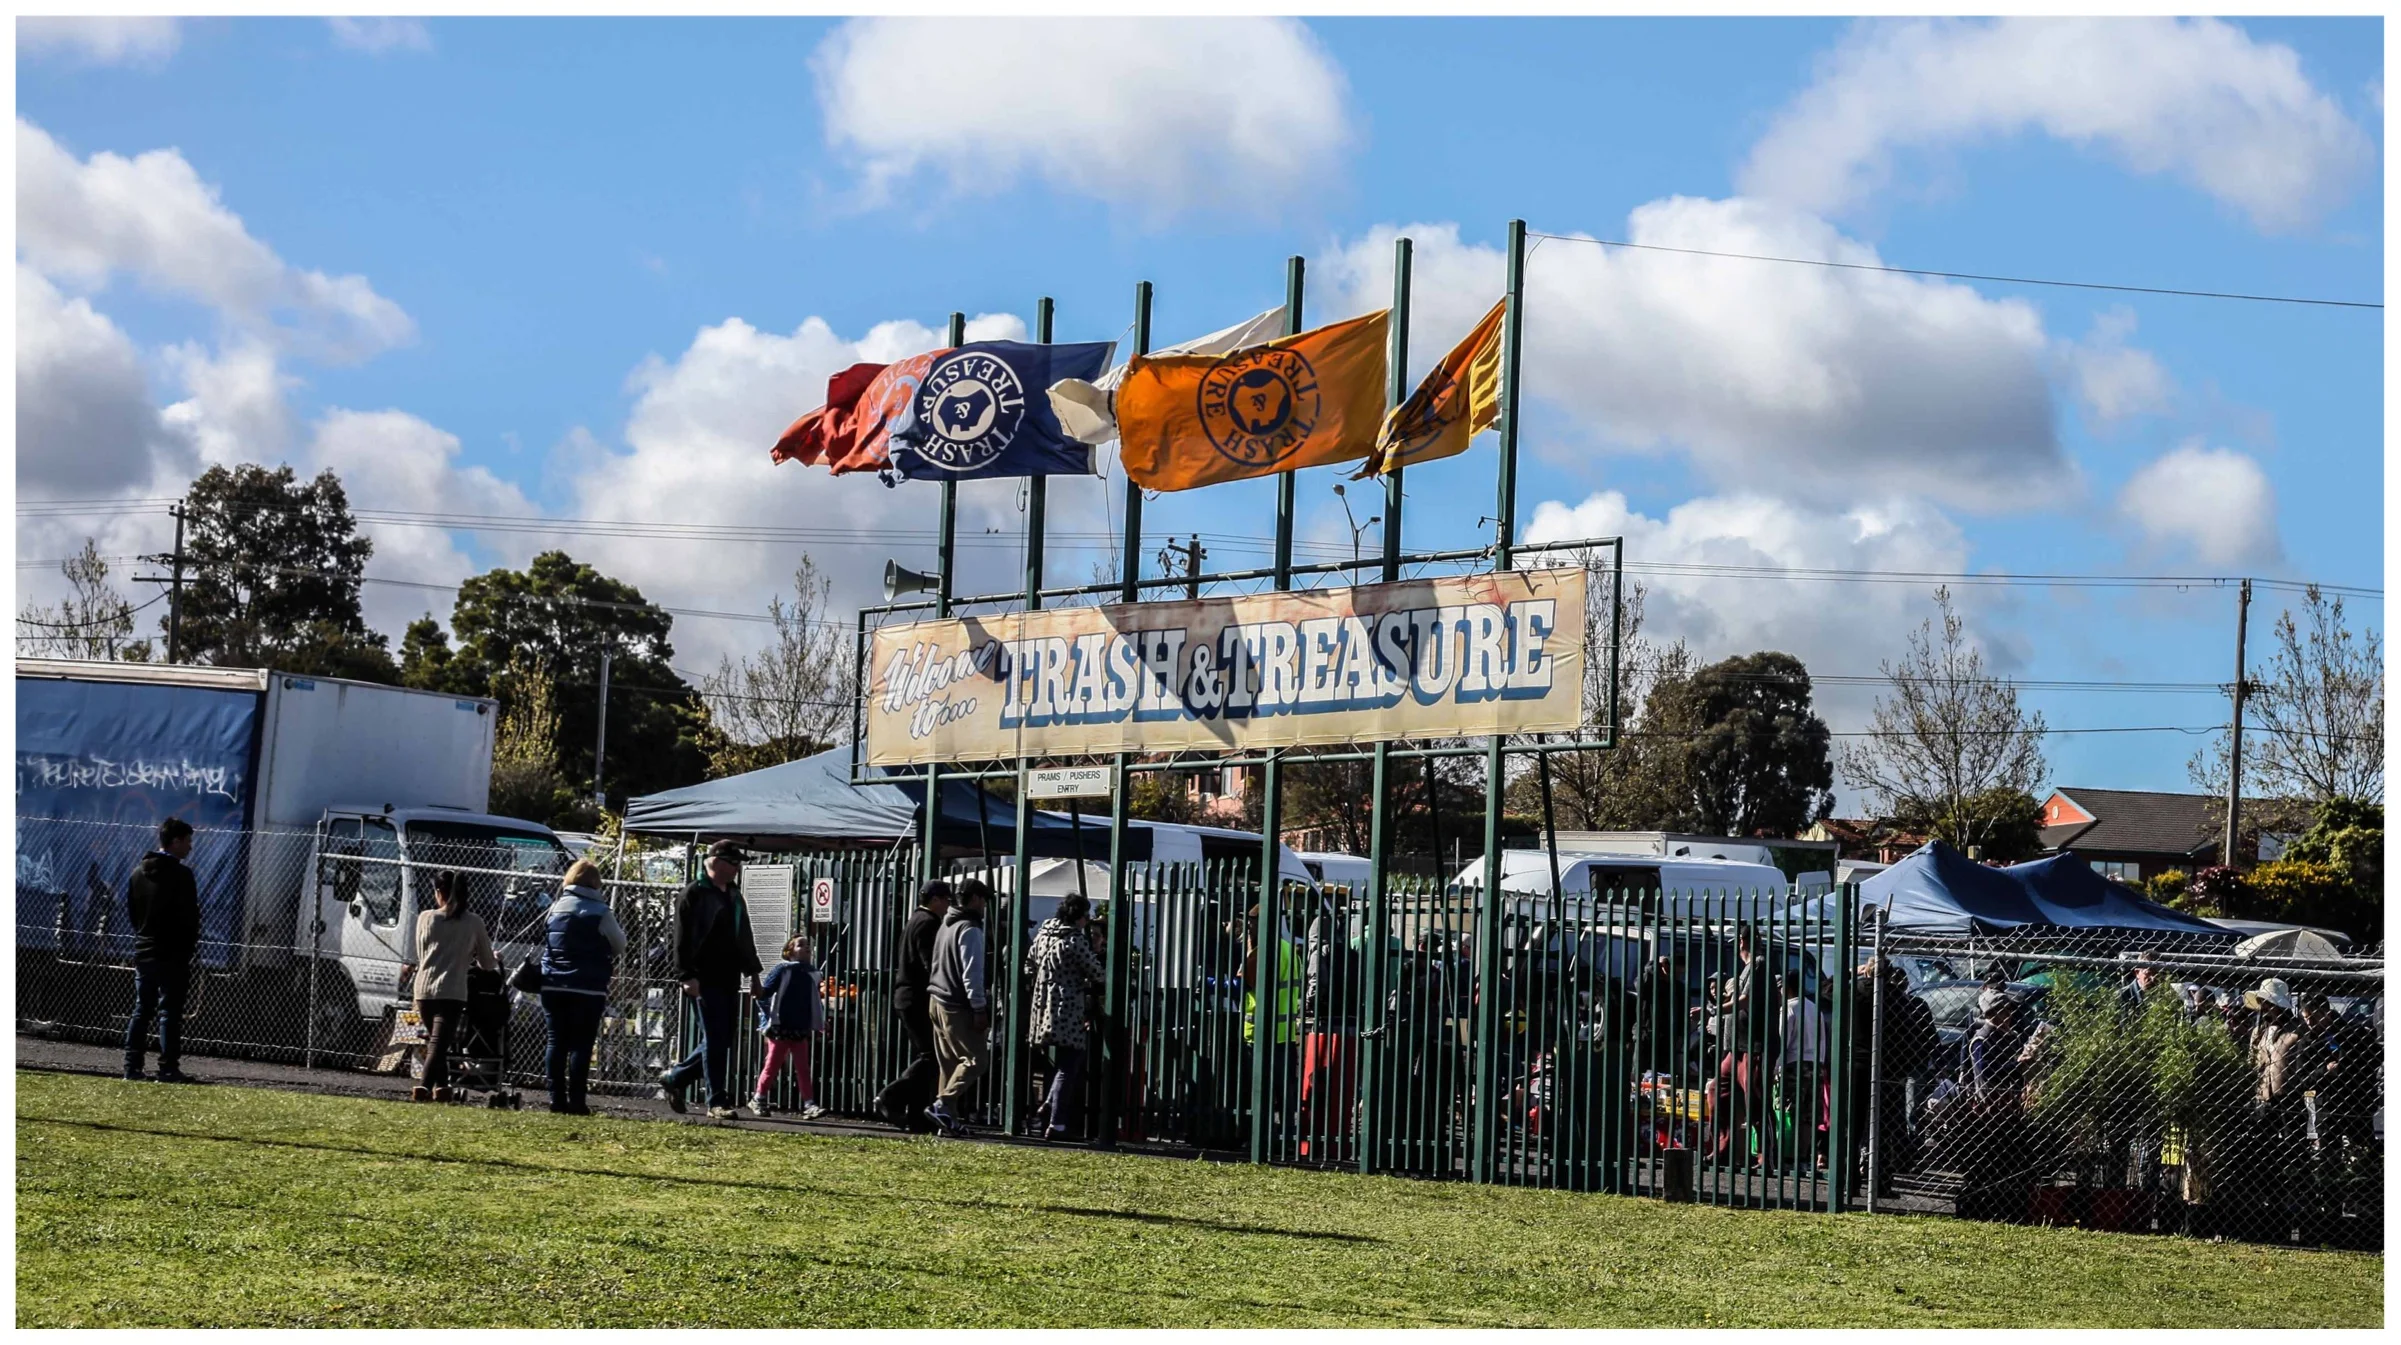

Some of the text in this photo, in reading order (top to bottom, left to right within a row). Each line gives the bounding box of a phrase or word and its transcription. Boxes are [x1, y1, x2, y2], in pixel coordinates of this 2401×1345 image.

[1205, 352, 1318, 418] TREASURE
[923, 427, 1015, 464] TRASH
[1222, 418, 1316, 460] TRASH
[882, 641, 996, 714] Welcome
[995, 628, 1188, 729] TRASH
[1217, 598, 1557, 720] TREASURE
[1037, 772, 1061, 782] PRAMS
[1069, 770, 1101, 780] PUSHERS
[1057, 784, 1079, 793] ENTRY
